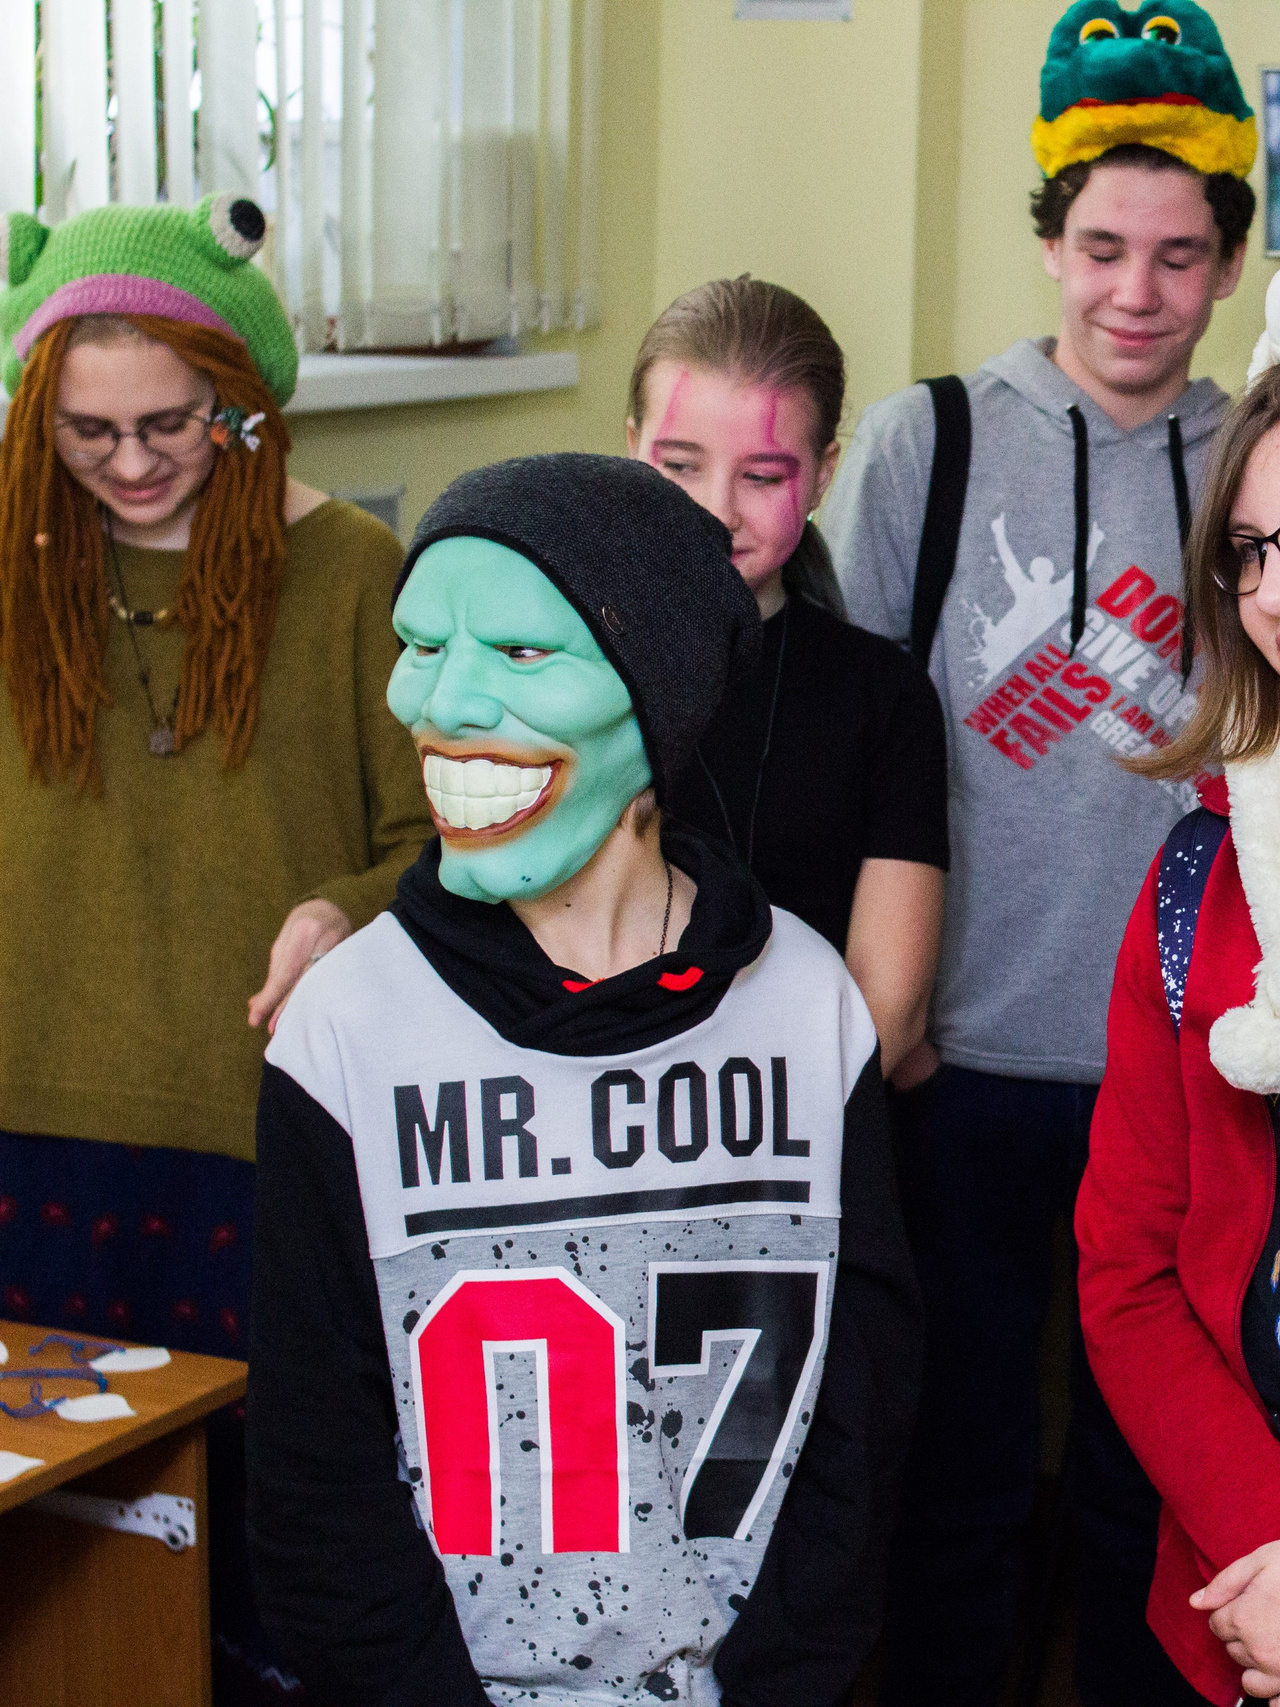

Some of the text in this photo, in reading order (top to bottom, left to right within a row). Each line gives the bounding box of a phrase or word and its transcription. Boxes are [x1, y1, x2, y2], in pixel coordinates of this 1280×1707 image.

[963, 643, 1071, 736] WHEN ALL
[1060, 608, 1161, 692] GIVE
[988, 662, 1113, 770] FAILS
[1120, 705, 1154, 735] AM
[393, 1056, 811, 1189] MR. COOL
